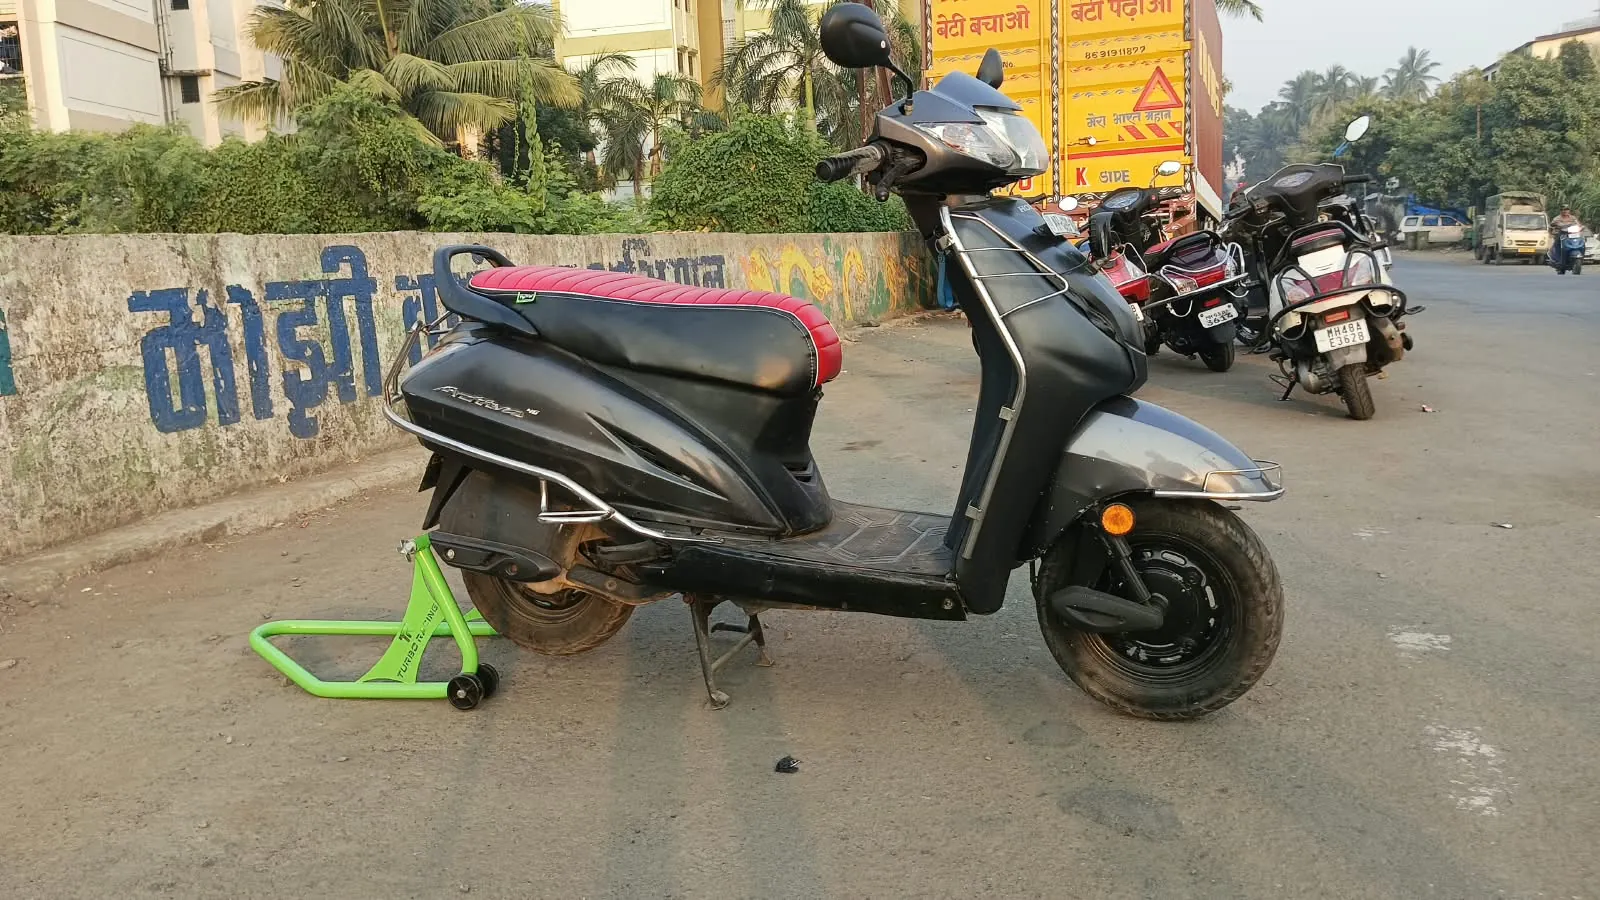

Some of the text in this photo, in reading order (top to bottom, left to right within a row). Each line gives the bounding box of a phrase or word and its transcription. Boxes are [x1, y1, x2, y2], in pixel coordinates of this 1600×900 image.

[936, 4, 1030, 39] बेटी बचाओ
[1145, 109, 1172, 123] महान
[1076, 167, 1089, 187] K
[1099, 170, 1131, 184] SIDE
[1326, 321, 1362, 338] MH48A
[1329, 331, 1365, 348] E3628
[397, 642, 419, 679] TURBO
[415, 603, 439, 643] RACING
